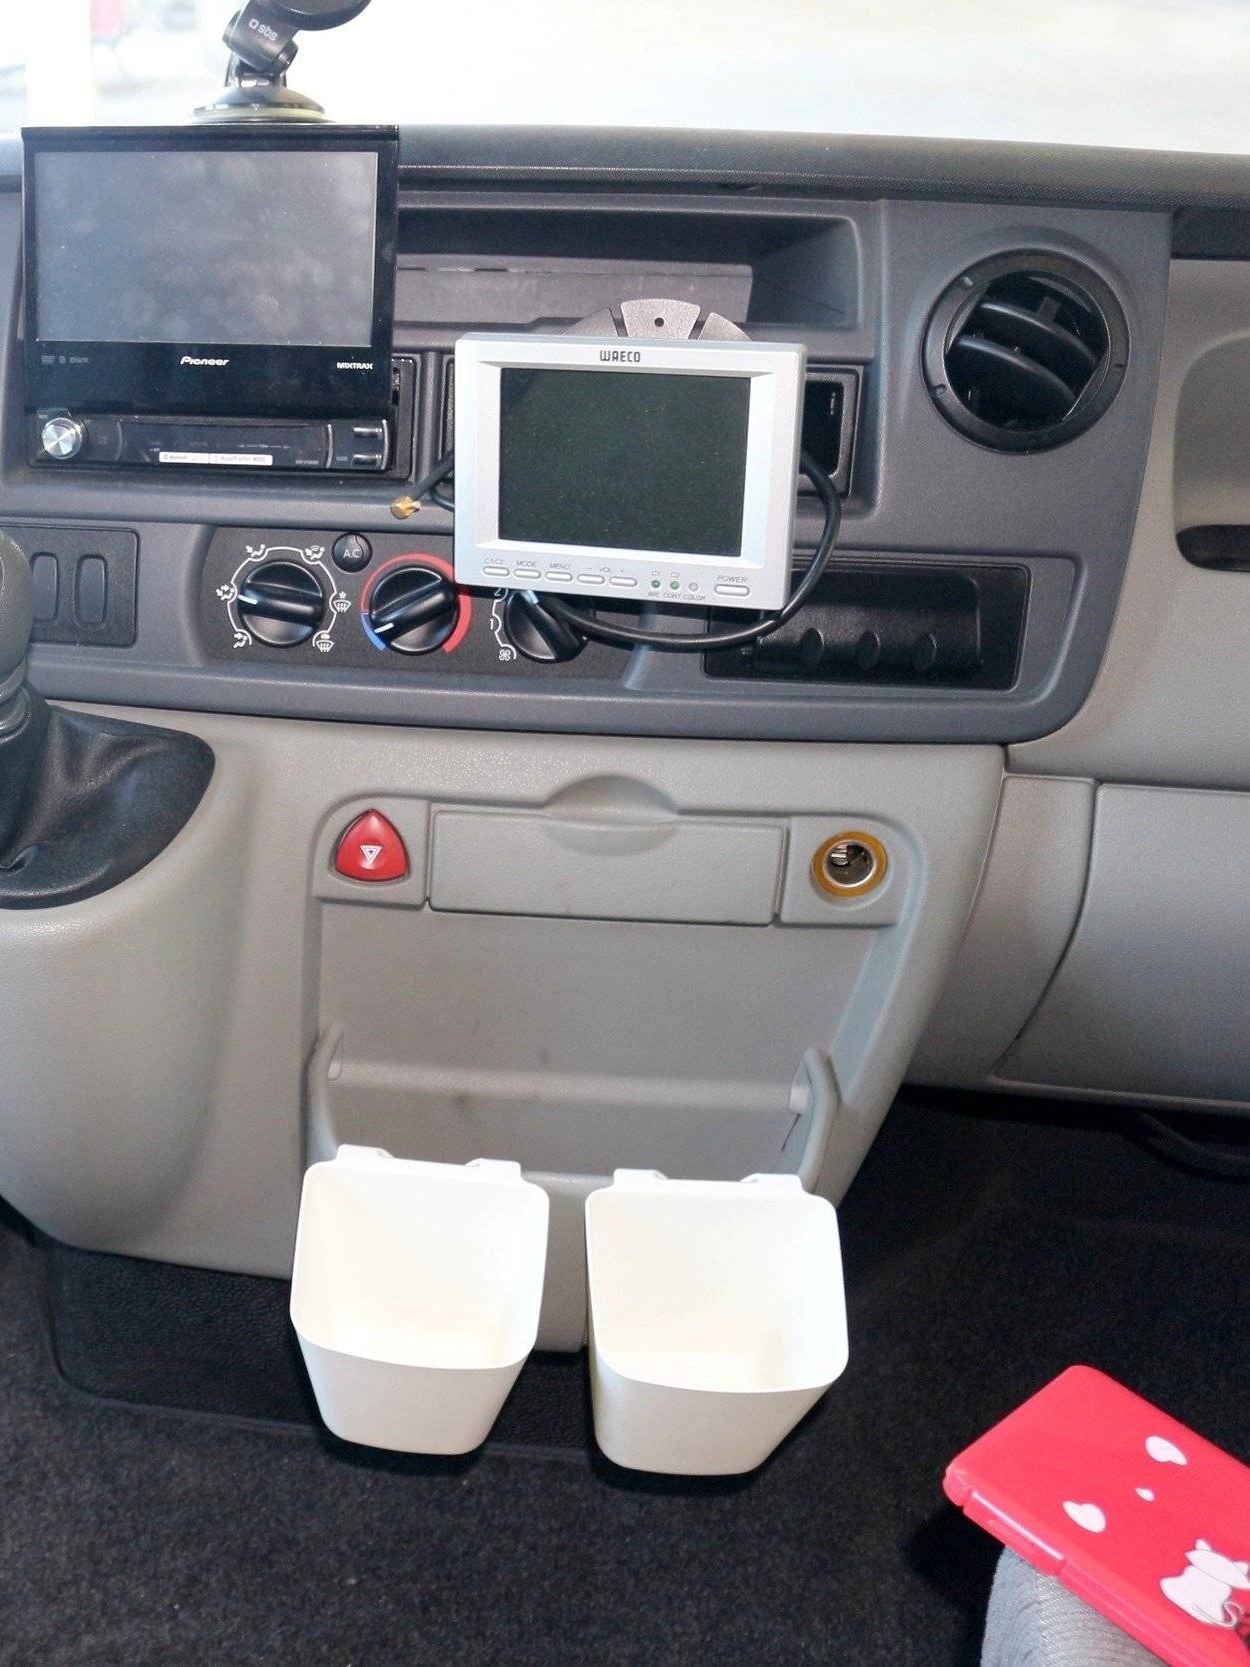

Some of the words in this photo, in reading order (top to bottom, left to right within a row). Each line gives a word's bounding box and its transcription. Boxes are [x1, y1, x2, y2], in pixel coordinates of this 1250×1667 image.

[258, 24, 278, 41] sbs
[180, 355, 229, 366] Pioneer
[599, 350, 641, 362] WAECO
[336, 361, 374, 370] MIXTRAX
[717, 575, 749, 584] POWER
